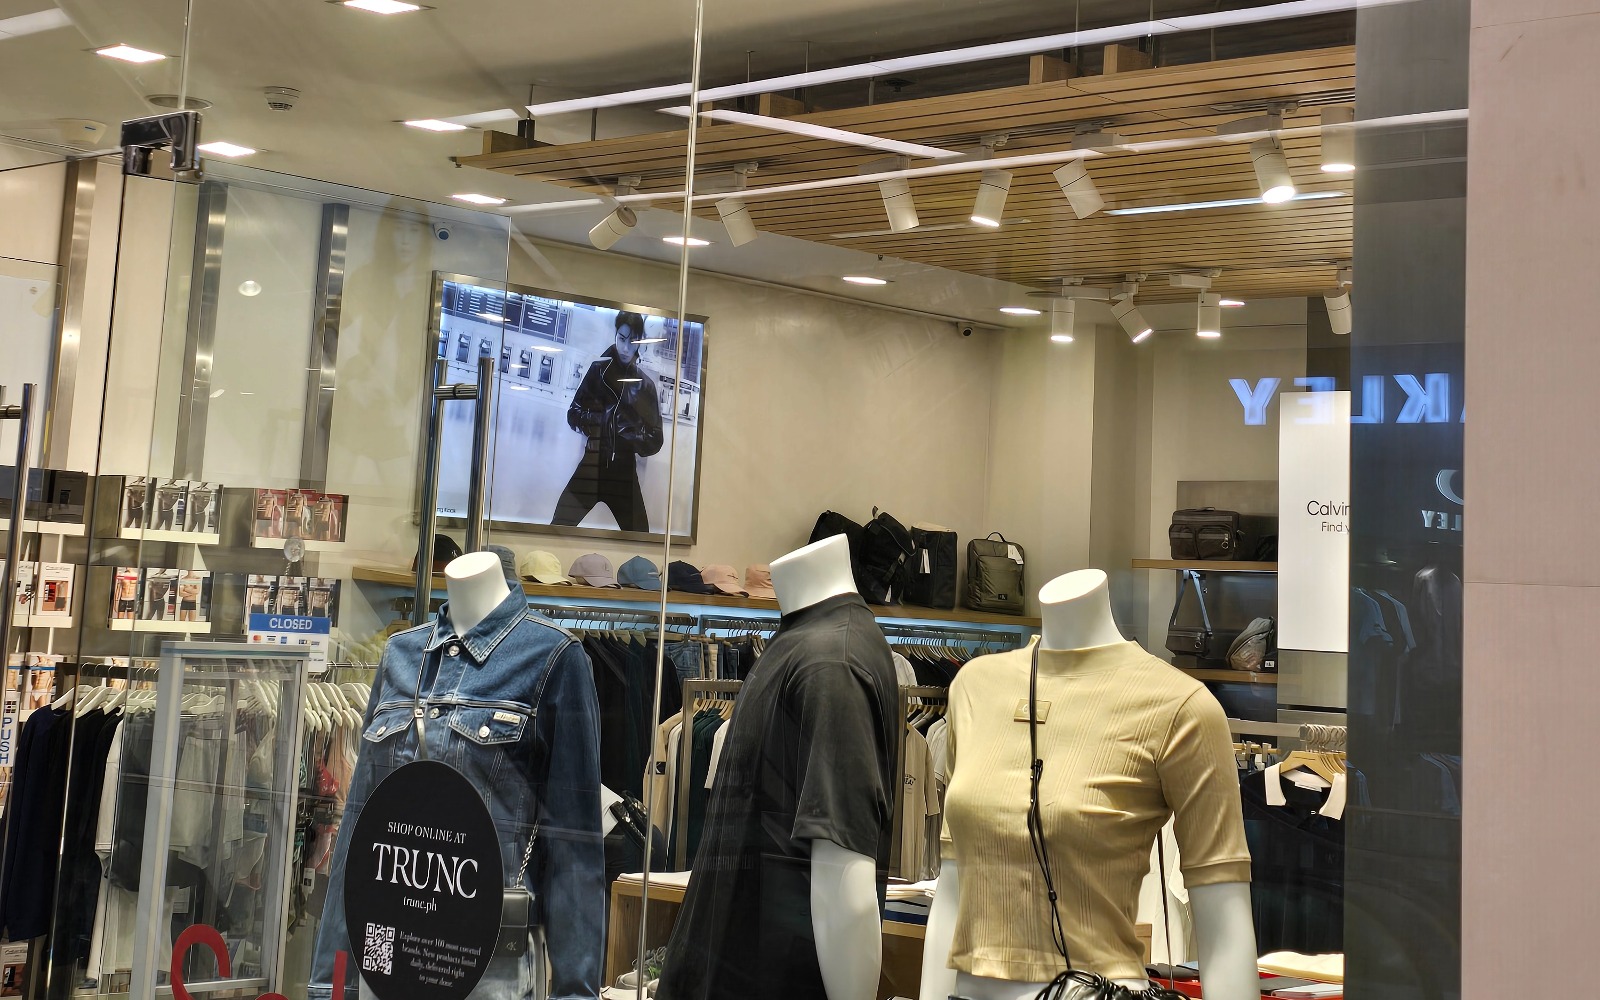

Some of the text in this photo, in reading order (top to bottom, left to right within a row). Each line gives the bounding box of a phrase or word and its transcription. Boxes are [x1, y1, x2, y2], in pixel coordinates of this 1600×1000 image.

[1321, 521, 1343, 532] Find
[269, 617, 313, 630] CLOSED
[0, 717, 13, 765] PUSH
[387, 821, 467, 844] SHOP ONLINE AT
[372, 842, 479, 899] TRUNC
[403, 896, 437, 914] trunc.ph
[399, 930, 421, 943] Explore
[420, 937, 434, 946] over
[434, 938, 446, 948] 100
[422, 947, 436, 958] New
[436, 952, 461, 964] products
